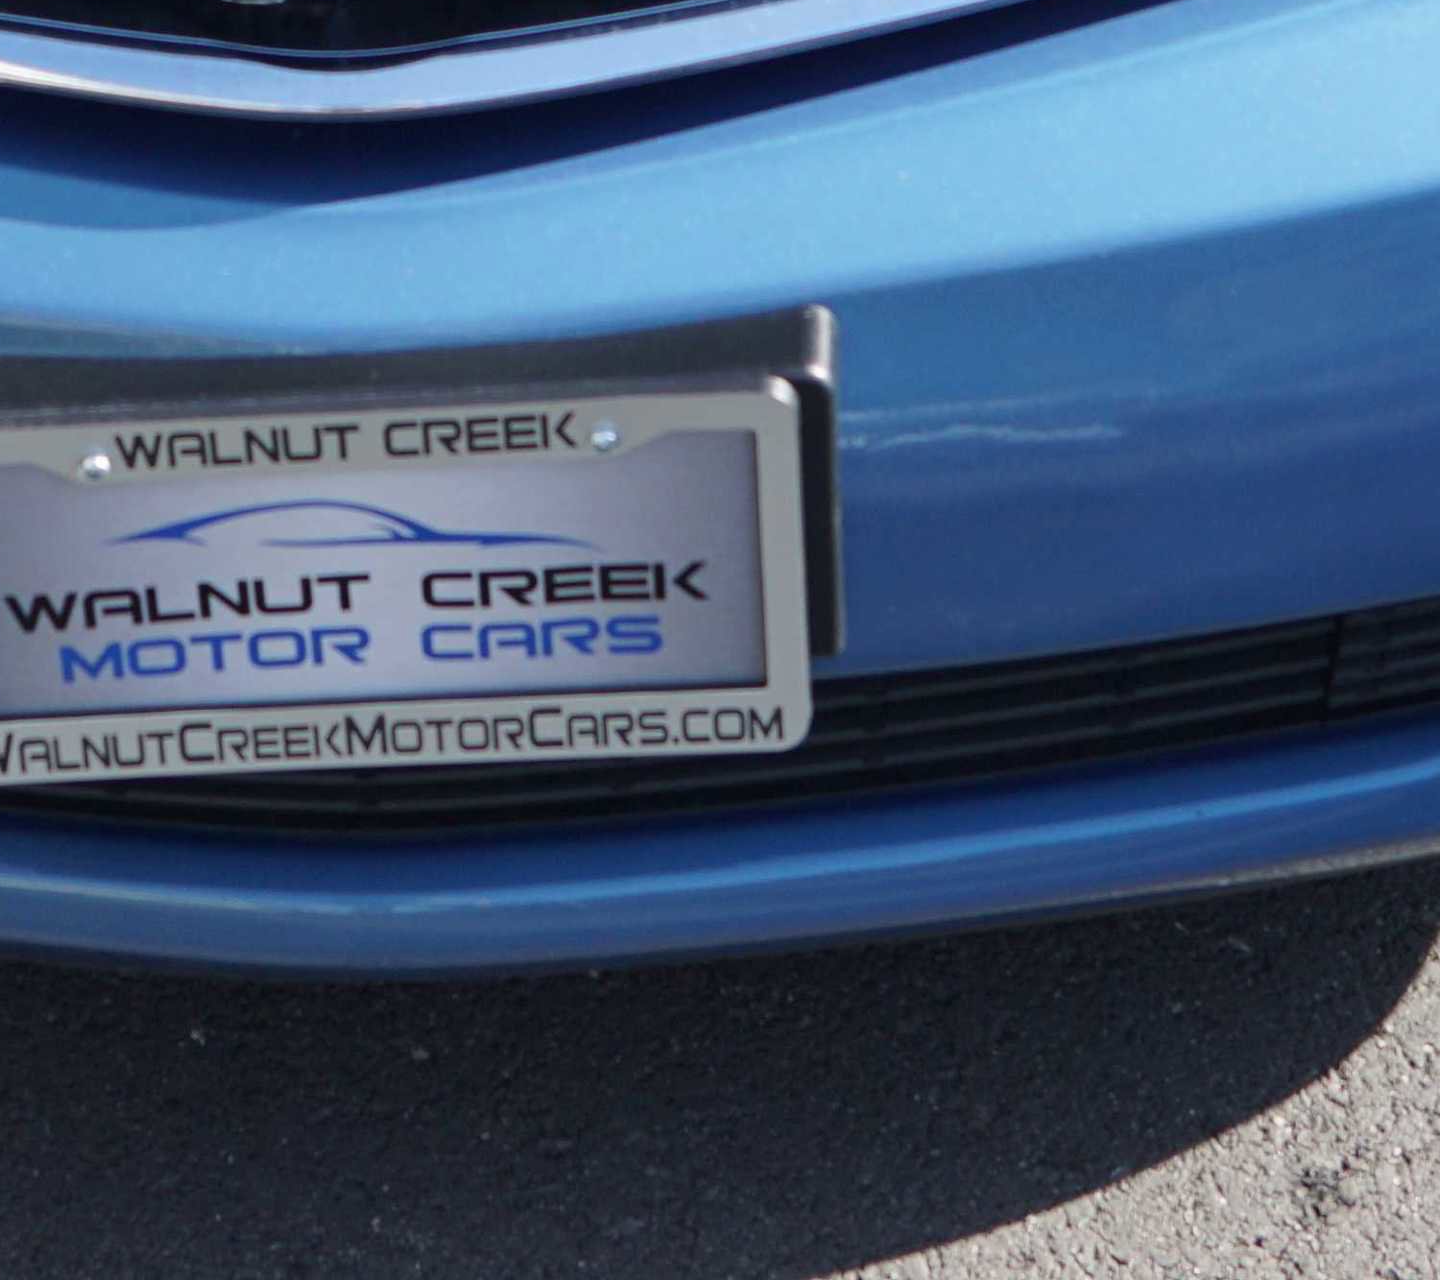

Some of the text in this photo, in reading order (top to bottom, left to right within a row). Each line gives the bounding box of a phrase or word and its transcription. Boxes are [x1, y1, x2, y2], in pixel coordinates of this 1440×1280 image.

[114, 410, 579, 470] WALNUT CREEK
[3, 560, 710, 632] WALNUT CREEK
[58, 615, 665, 684] MOTOR CARS
